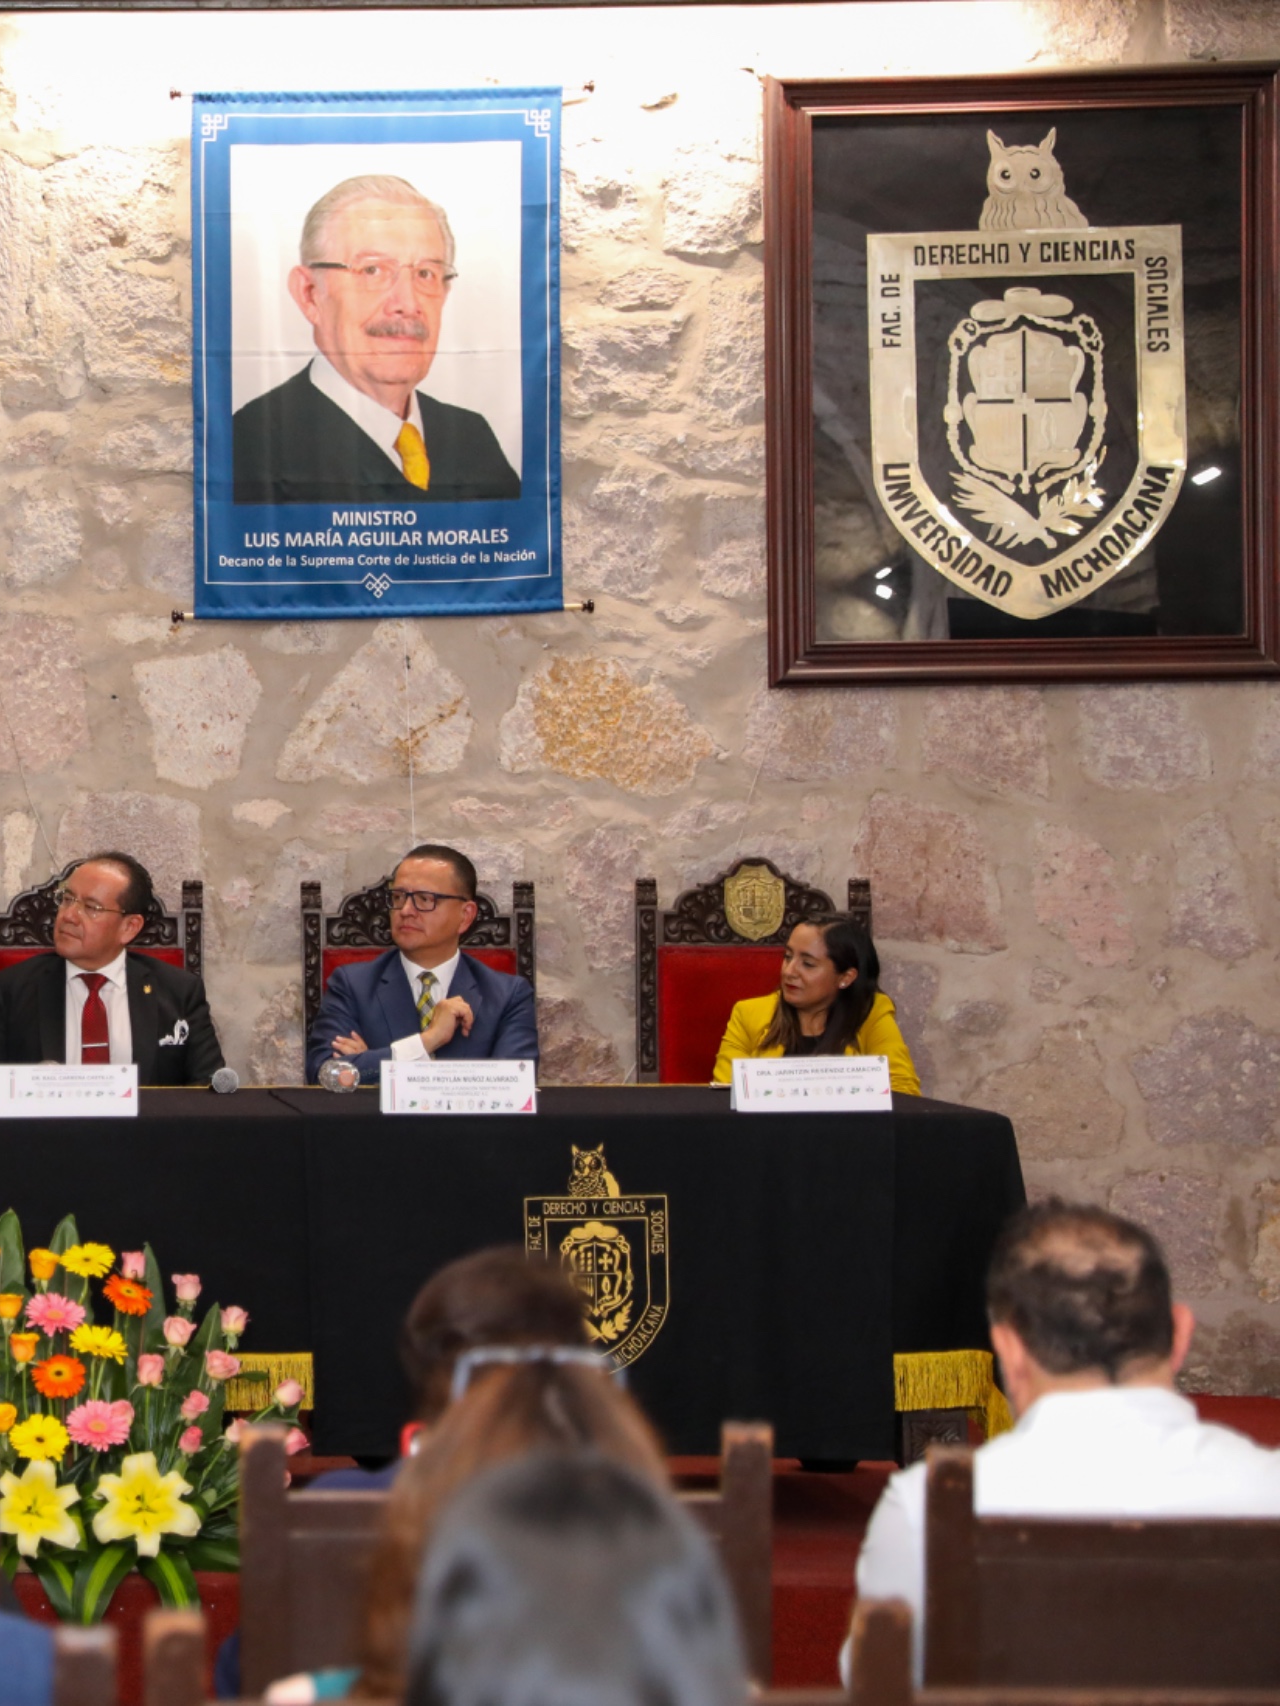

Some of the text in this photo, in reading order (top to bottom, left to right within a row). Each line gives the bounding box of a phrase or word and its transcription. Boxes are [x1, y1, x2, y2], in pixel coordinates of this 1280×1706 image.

[913, 239, 1135, 266] DERECHO Y CIENCIAS
[881, 273, 902, 348] FAC. DE
[1145, 256, 1170, 353] SOCIALES
[332, 510, 417, 526] MINISTRO
[883, 463, 1013, 598] UNIVERSIDAD
[1040, 466, 1175, 598] MICHOACANA
[244, 528, 509, 548] LUIS MARÍA AGUILAR MORALES
[219, 549, 536, 569] Decano de la Suprema Corte de Justicia de la Nación
[528, 1215, 541, 1227] DE
[543, 1200, 646, 1215] DERECHO Y CIENCIAS
[650, 1210, 664, 1254] SOCIALES
[612, 1305, 664, 1367] MICHOACANA
